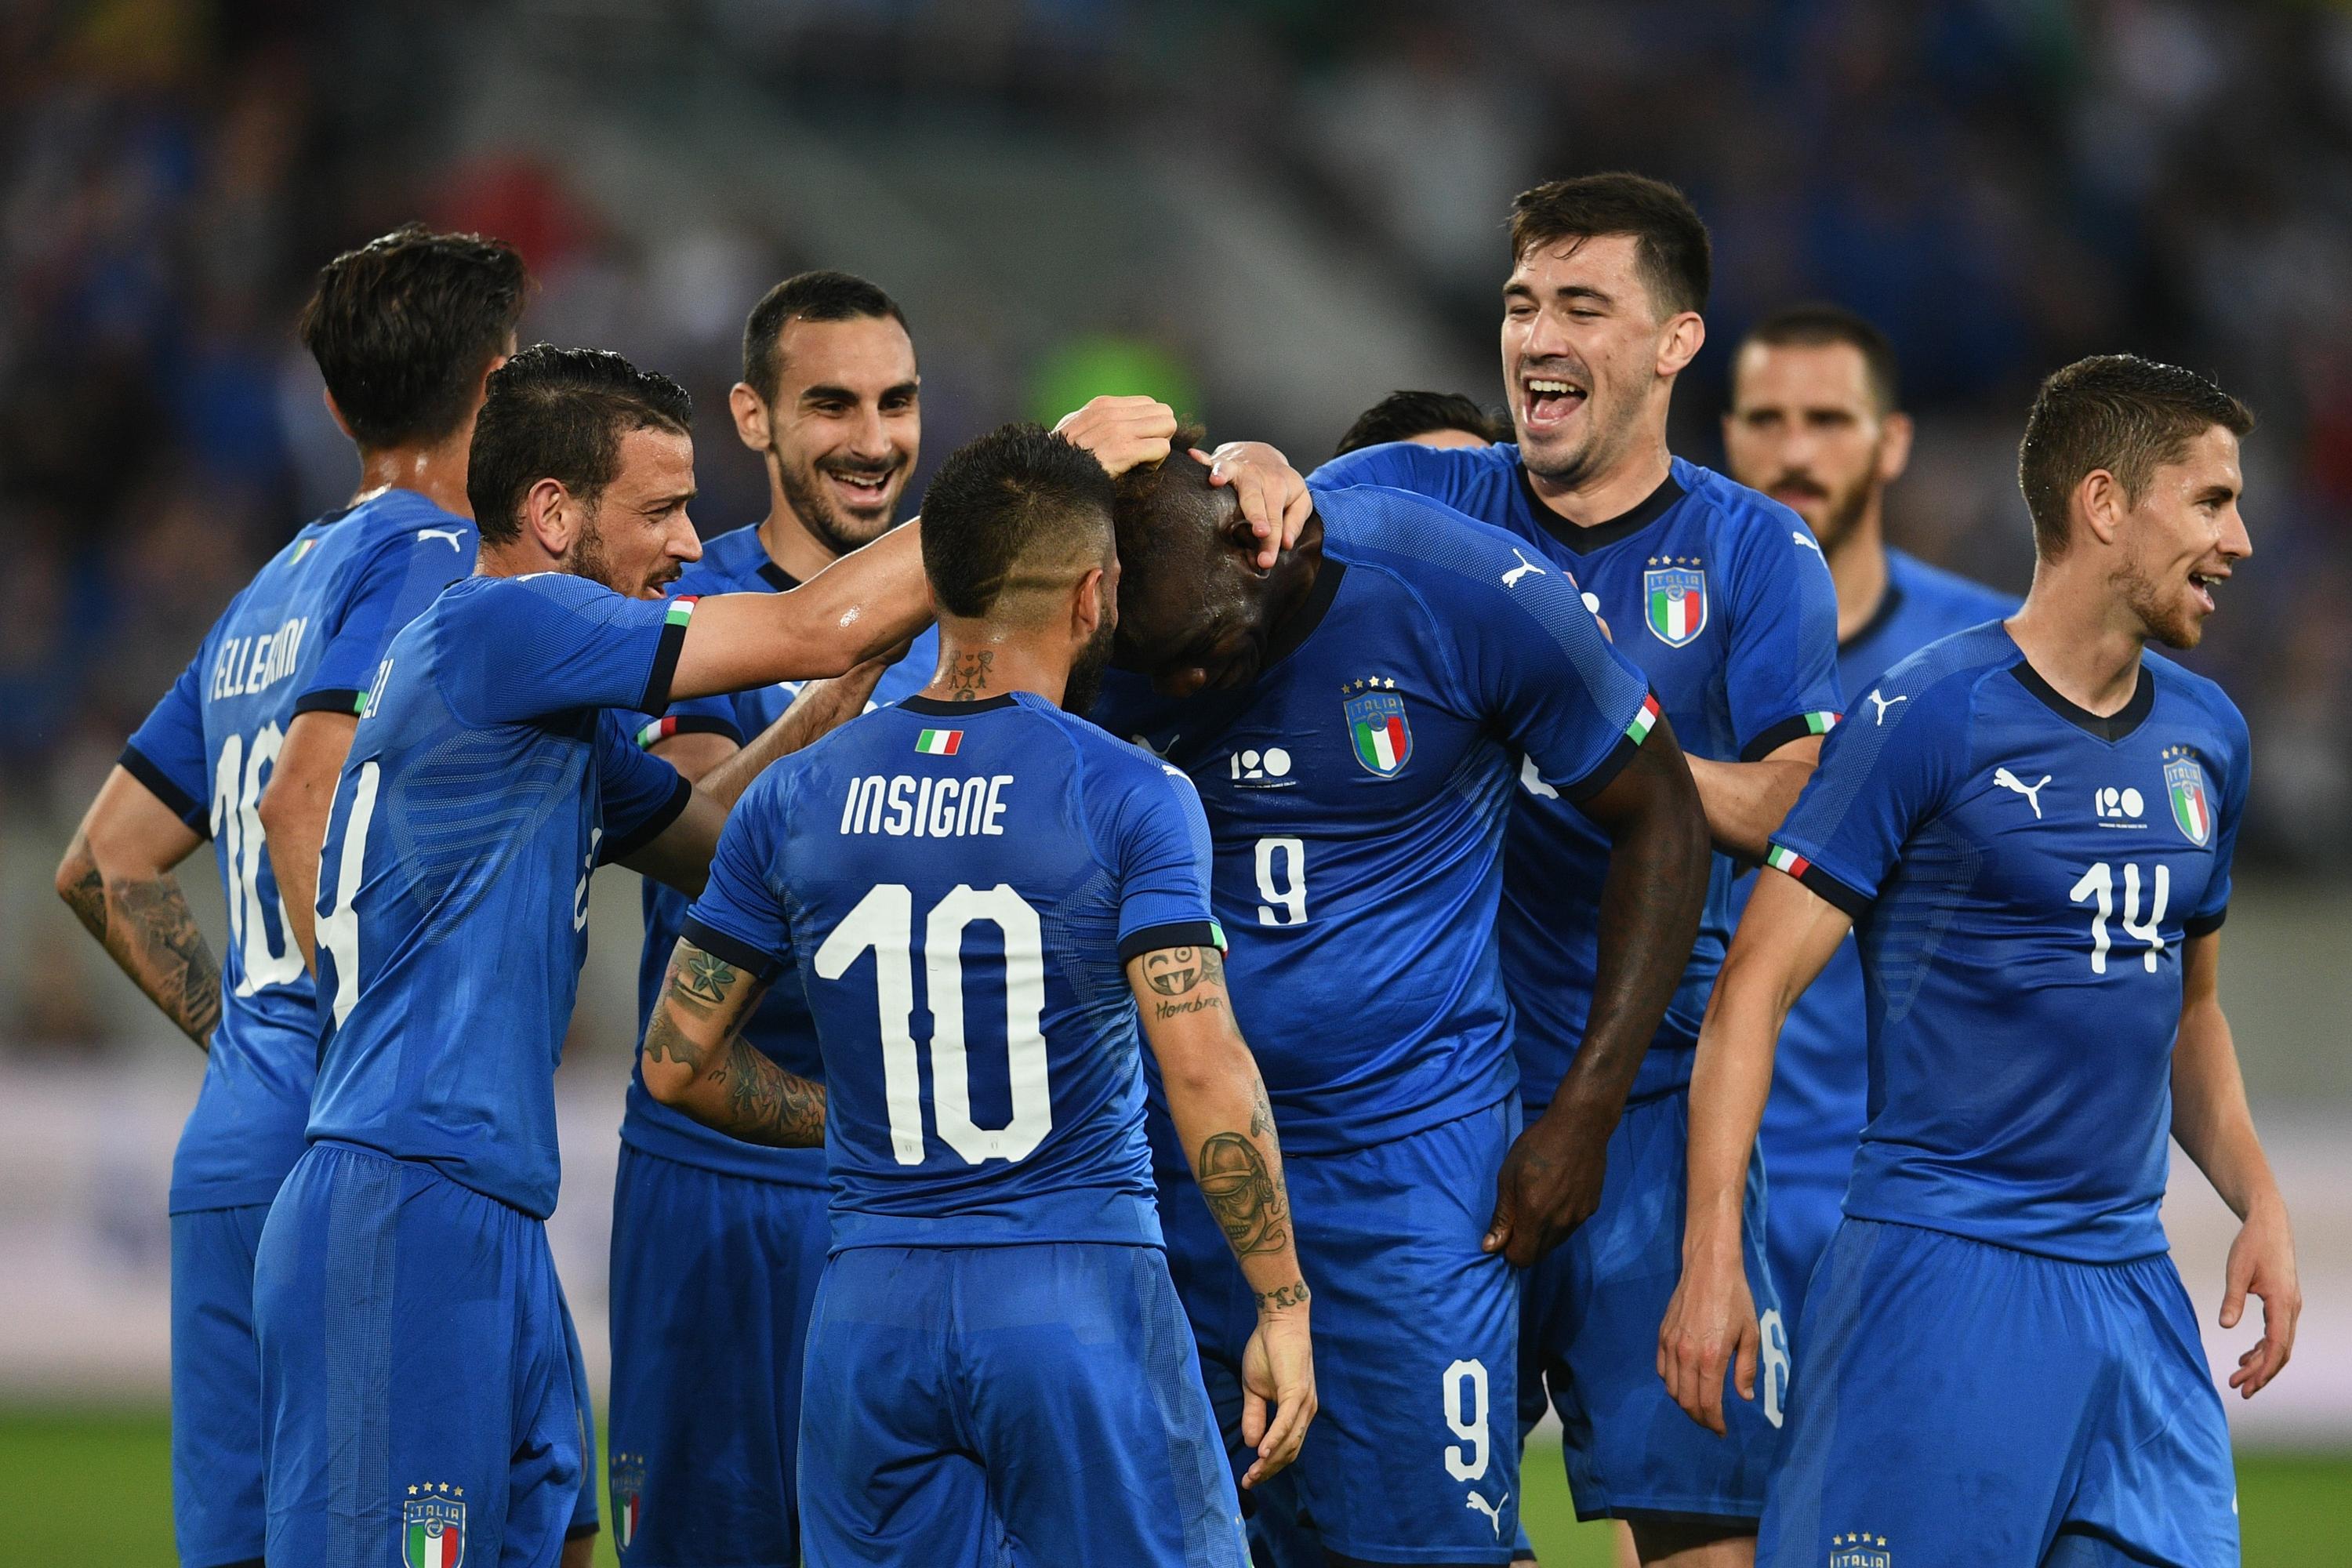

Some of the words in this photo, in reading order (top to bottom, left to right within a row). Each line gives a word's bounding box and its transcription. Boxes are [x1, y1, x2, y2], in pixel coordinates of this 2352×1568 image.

[1650, 575, 1699, 586] ITALIA
[1350, 698, 1397, 717] ITALIA
[840, 775, 1014, 837] INSIGNE
[1254, 837, 1308, 926] 9
[2070, 862, 2169, 974] 14
[814, 884, 1053, 1165] 10
[1760, 1308, 1790, 1428] 6
[1443, 1359, 1490, 1482] 9
[410, 1505, 459, 1519] ITALIA
[1837, 1555, 1884, 1568] ITALIA
